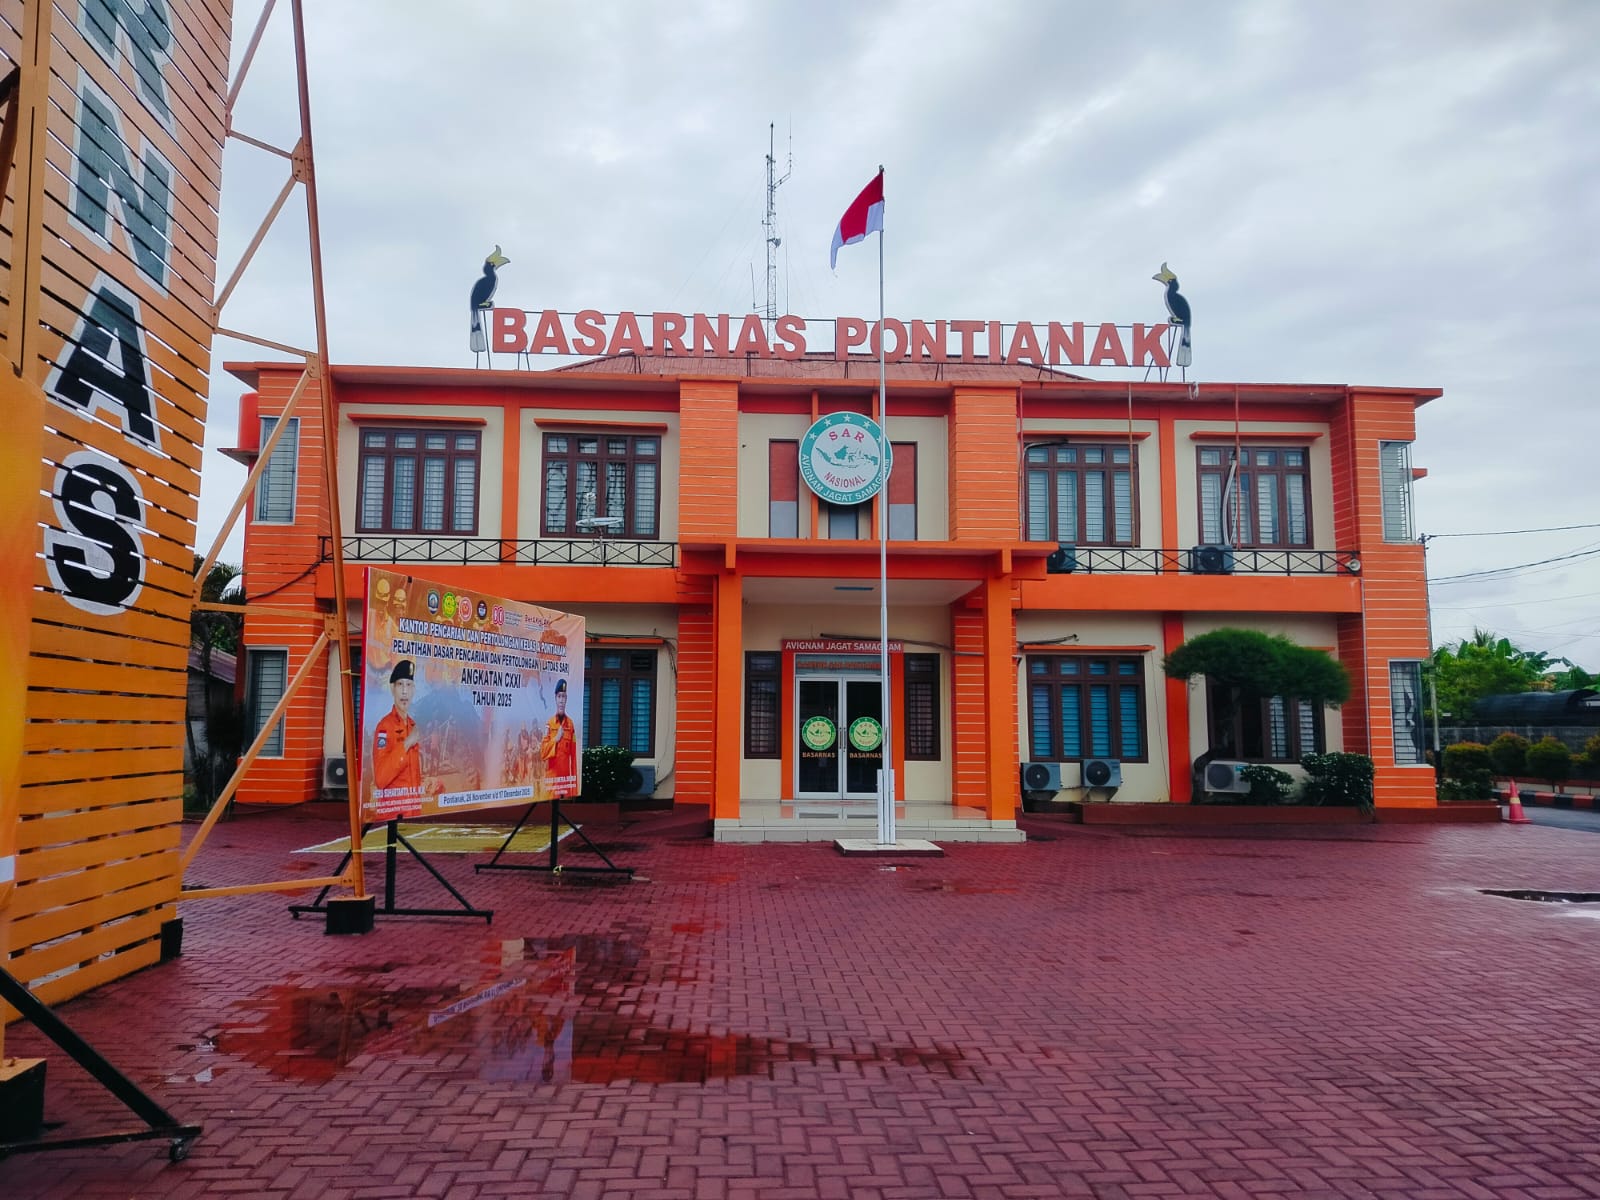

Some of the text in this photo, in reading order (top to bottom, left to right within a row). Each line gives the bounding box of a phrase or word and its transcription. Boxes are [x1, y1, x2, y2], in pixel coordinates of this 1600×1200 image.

[492, 307, 1171, 367] BASARNAS PONTIANAK
[829, 428, 865, 442] SAR
[801, 454, 824, 492] AVIGNAM
[823, 487, 853, 502] JAGAT
[824, 472, 866, 488] NASIONAL
[399, 617, 429, 635] KANTOR
[430, 622, 466, 641] PENCARIAN
[467, 629, 480, 643] DAN
[480, 631, 519, 649] PERTOLONGAN
[393, 639, 432, 657] PELATIHAN
[433, 645, 454, 659] DASAR
[455, 647, 489, 664] PENCARIAN
[490, 652, 501, 665] DAN
[502, 654, 539, 669] PERTOLONGAN
[785, 642, 901, 651] AVIGNAM JAGAT SAMAGAM
[461, 667, 521, 688] ANGKATAN CXXI
[472, 690, 513, 707] TAHUN 2025
[472, 792, 492, 801] November
